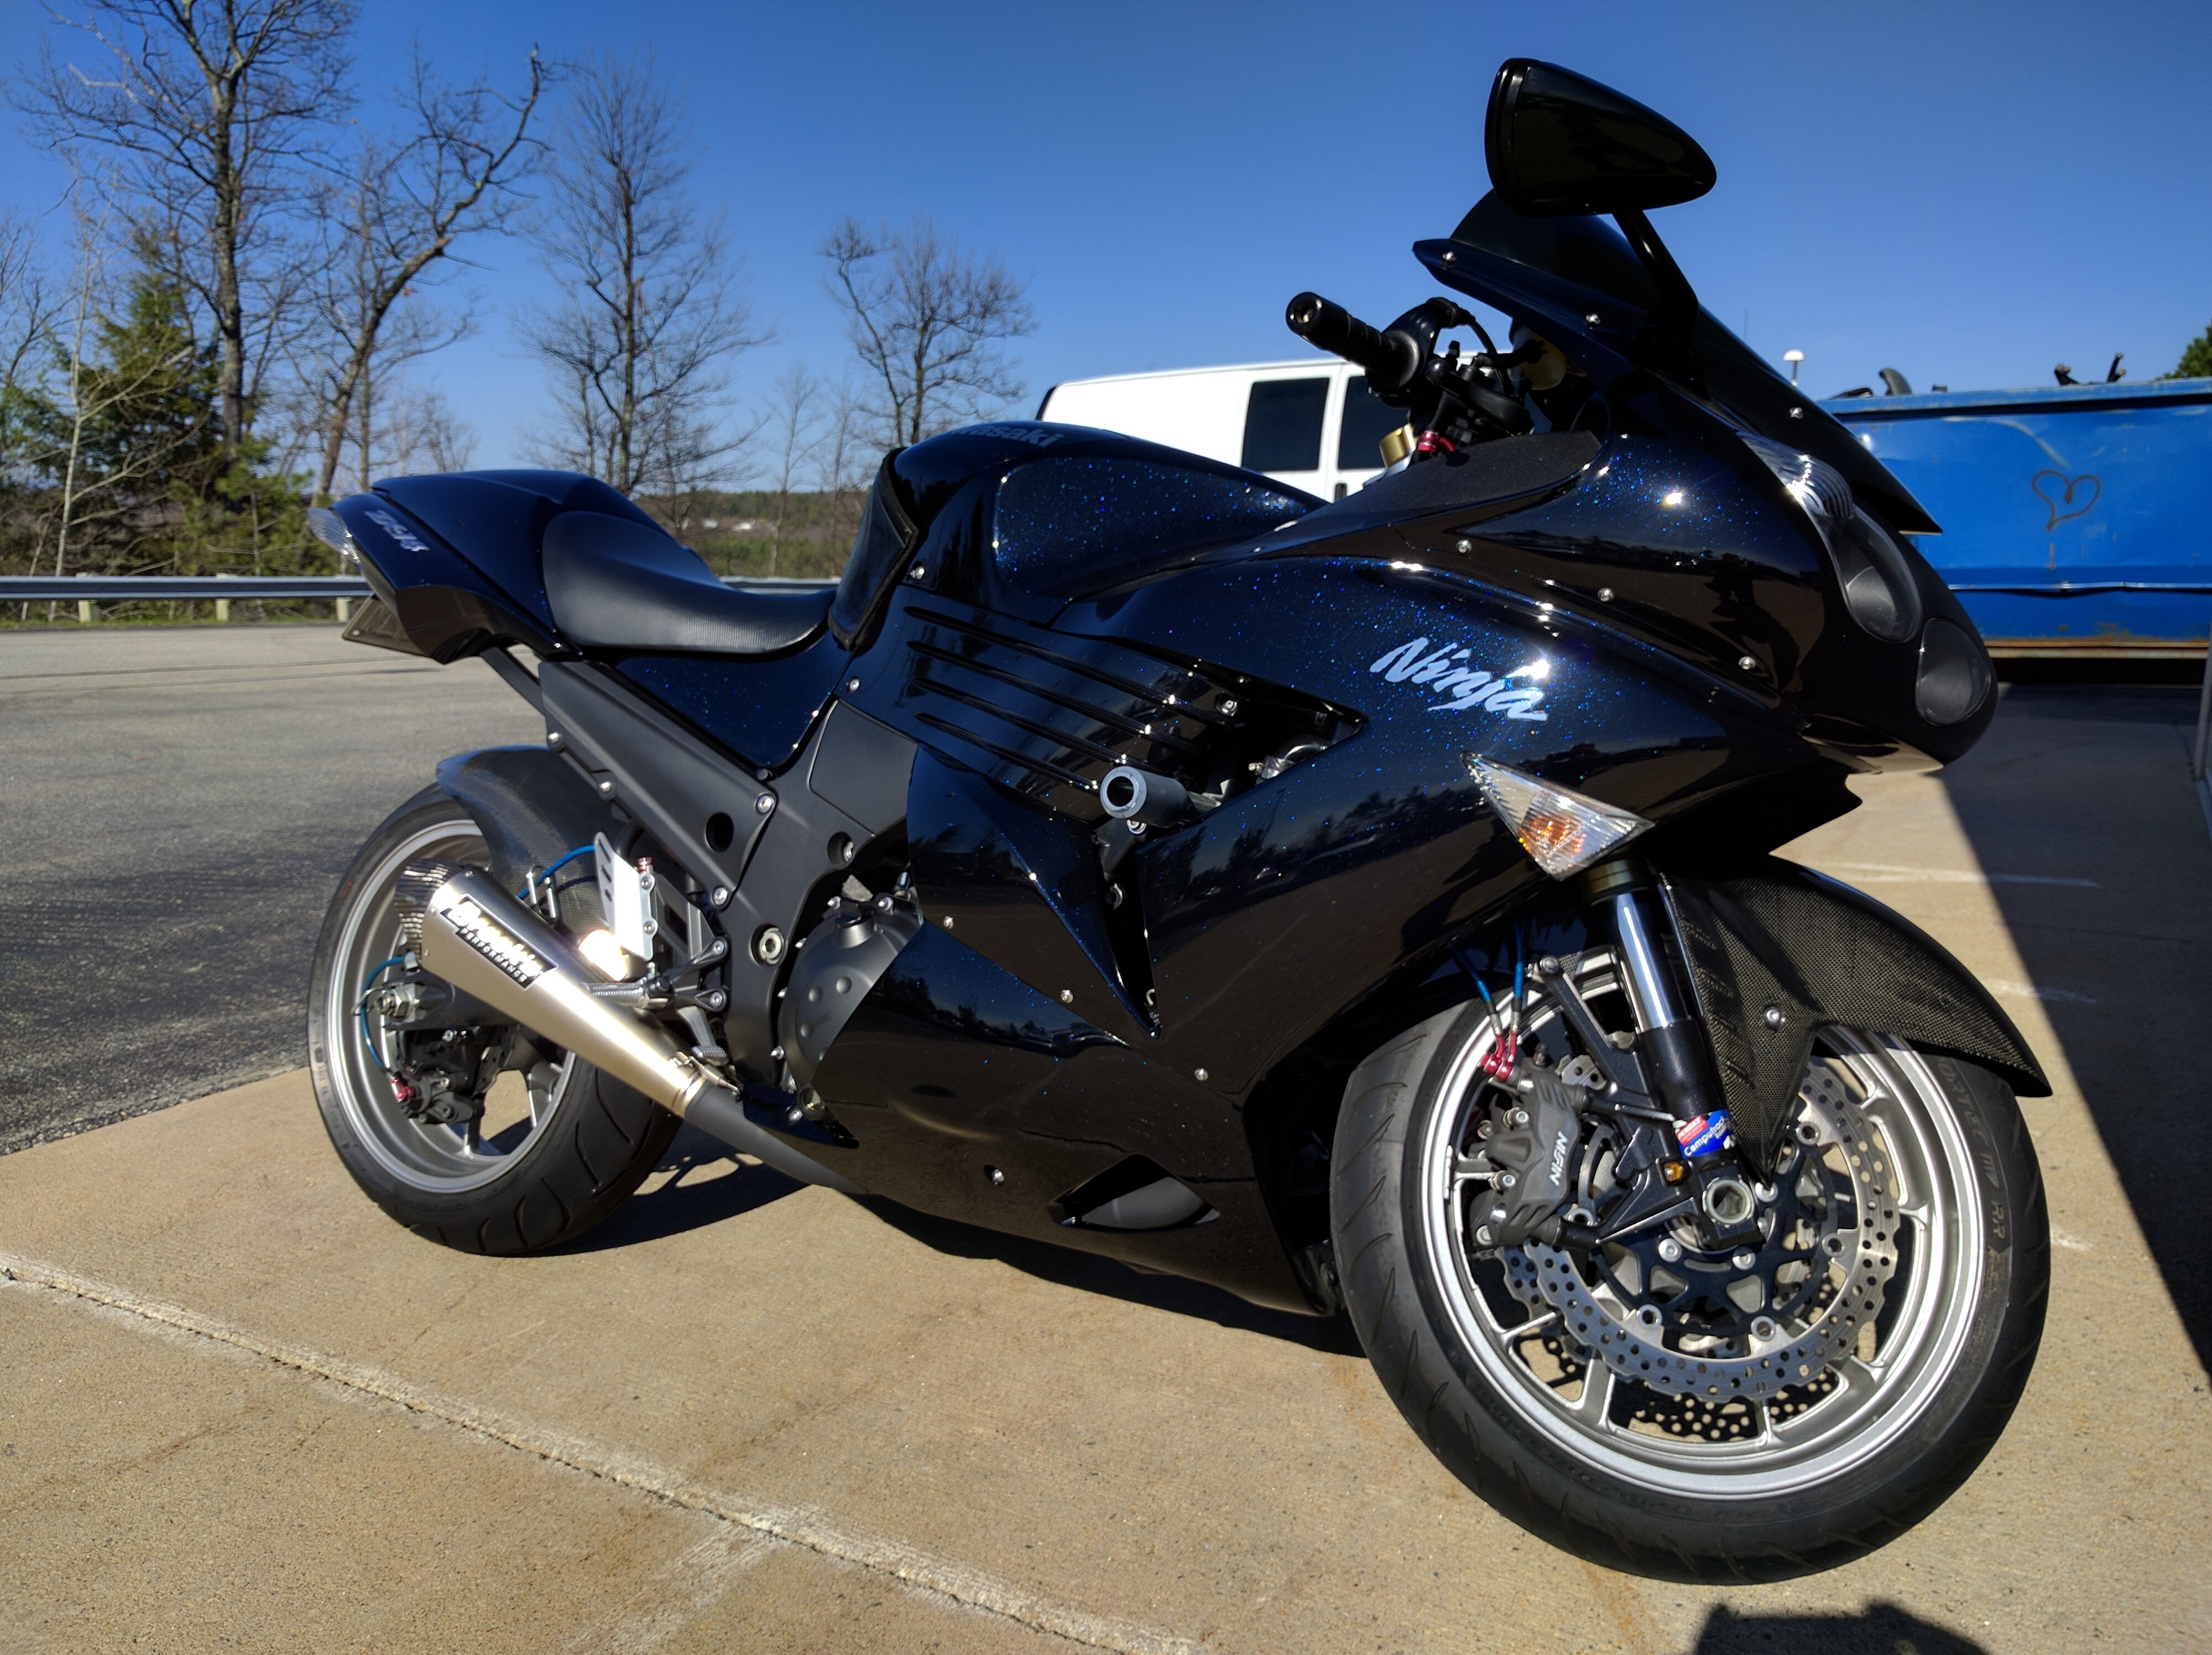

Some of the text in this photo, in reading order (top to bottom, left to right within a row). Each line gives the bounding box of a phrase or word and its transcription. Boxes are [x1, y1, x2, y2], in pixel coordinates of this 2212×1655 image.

[1370, 637, 1550, 721] Ninja
[460, 928, 528, 983] PERFORMANCE
[1549, 1131, 1568, 1186] NISSIN
